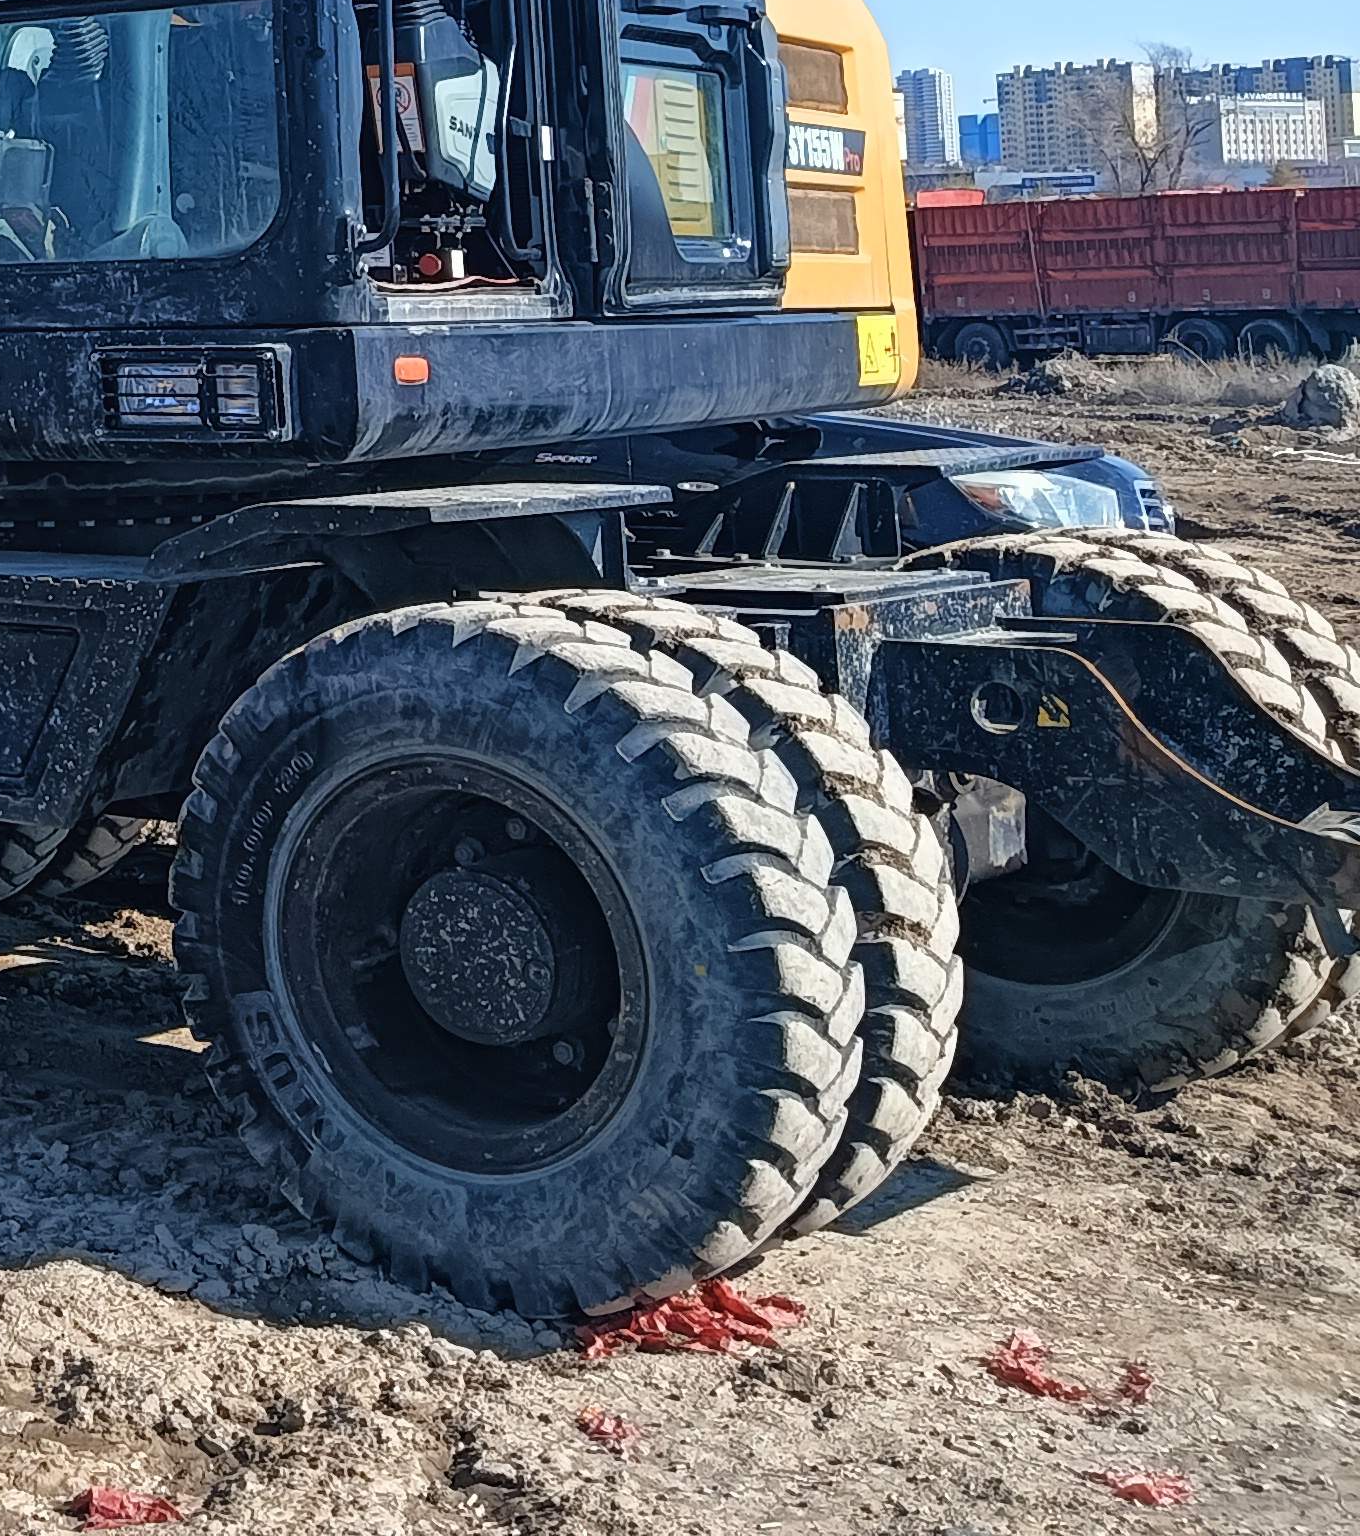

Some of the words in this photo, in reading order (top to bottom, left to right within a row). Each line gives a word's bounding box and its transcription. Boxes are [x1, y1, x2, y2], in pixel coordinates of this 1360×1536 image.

[449, 116, 478, 140] SAN
[788, 125, 844, 171] SY155W
[844, 146, 861, 172] Pro
